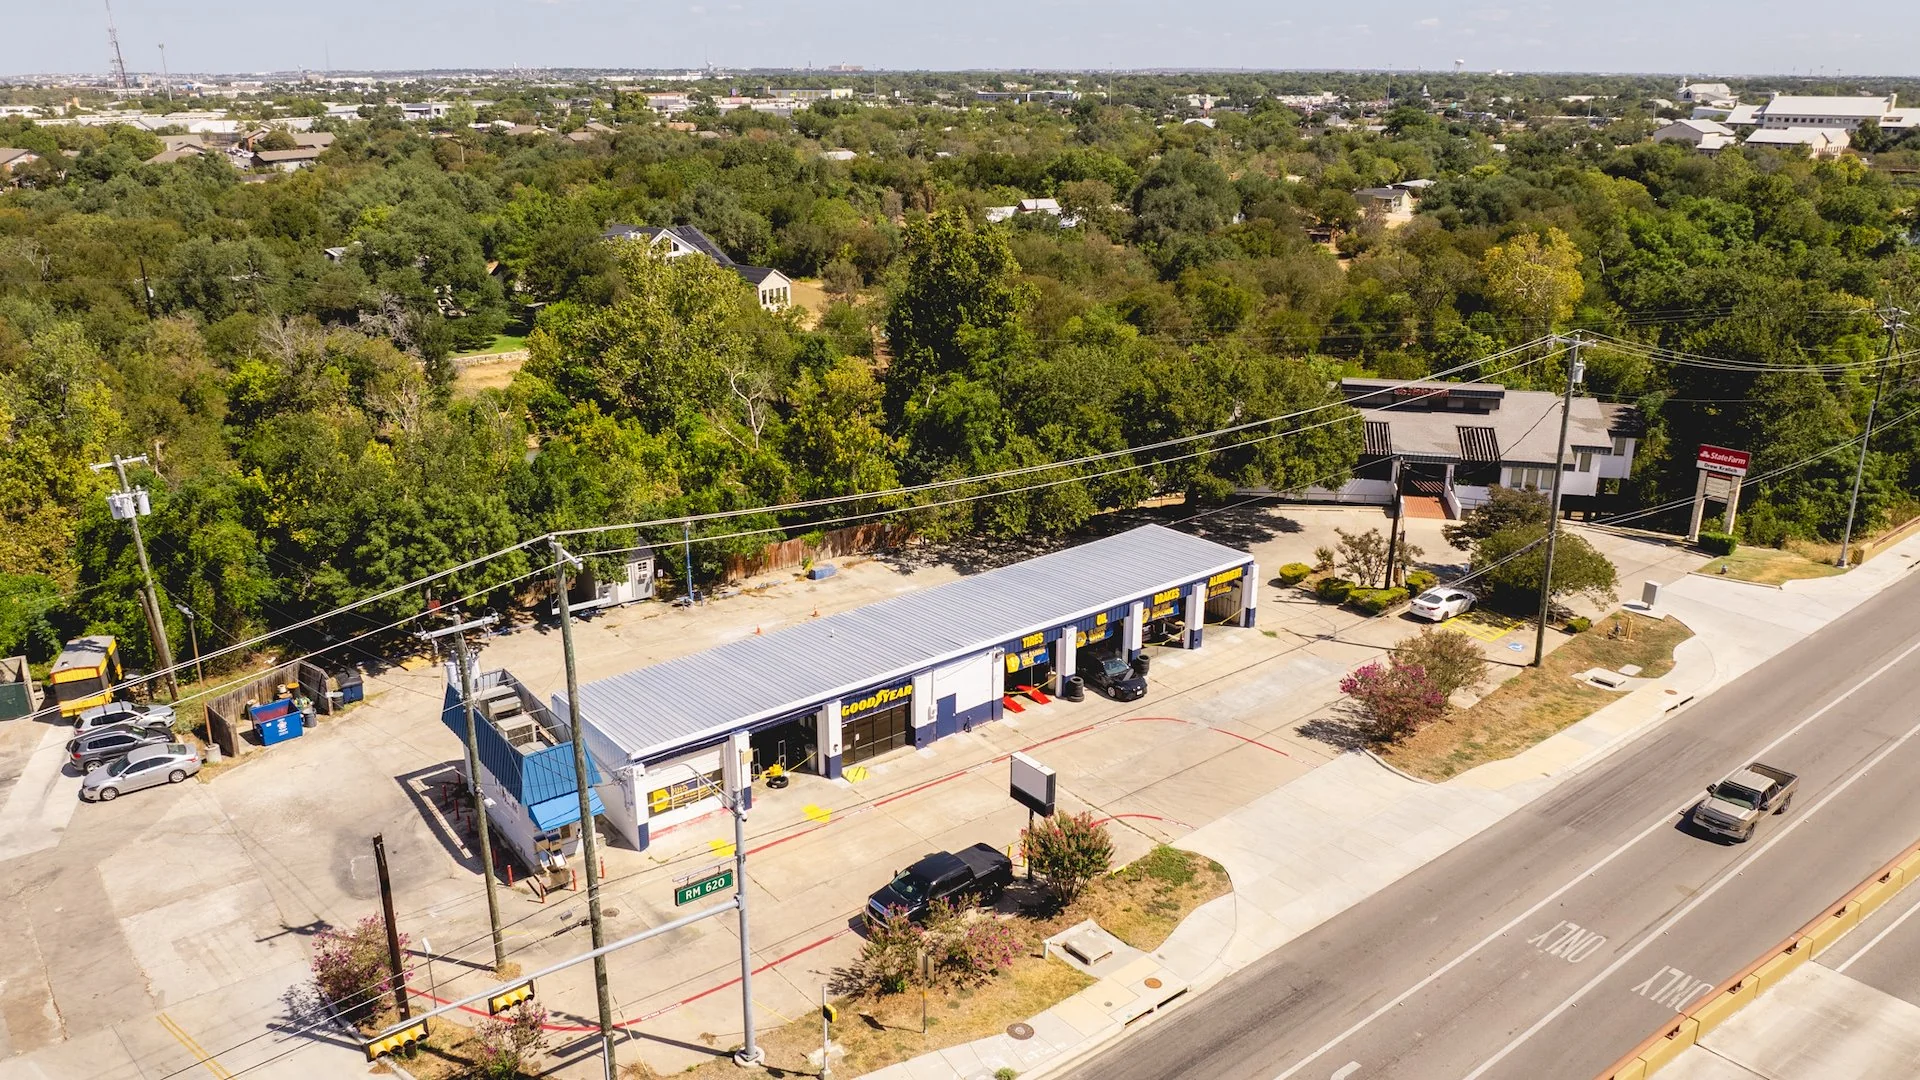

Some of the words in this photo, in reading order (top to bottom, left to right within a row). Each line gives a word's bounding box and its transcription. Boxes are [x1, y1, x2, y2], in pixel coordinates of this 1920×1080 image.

[1154, 587, 1180, 605] BRAKES
[1022, 632, 1044, 649] TIRES
[841, 684, 913, 717] GOODYEAR
[685, 886, 701, 900] RM
[705, 878, 725, 892] 620
[1527, 920, 1607, 963] ONLY
